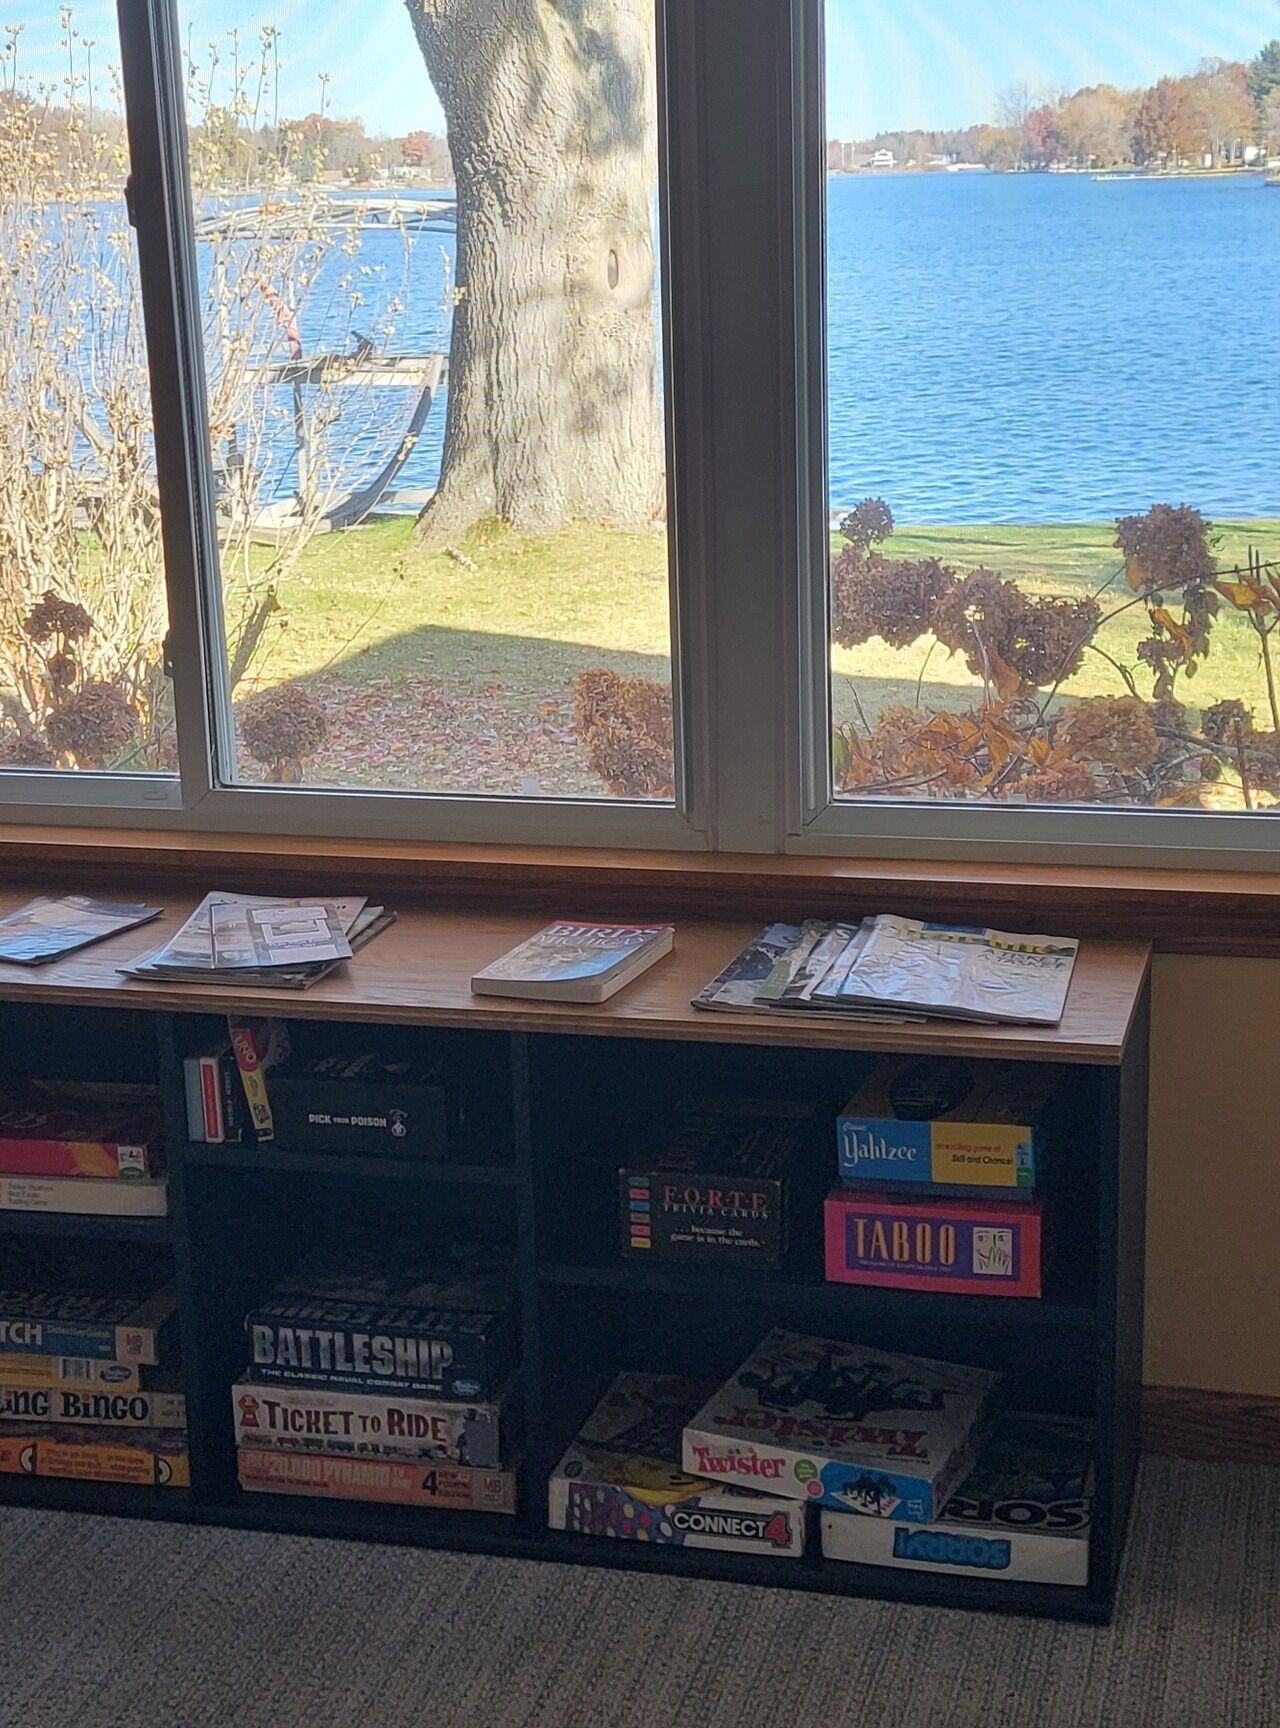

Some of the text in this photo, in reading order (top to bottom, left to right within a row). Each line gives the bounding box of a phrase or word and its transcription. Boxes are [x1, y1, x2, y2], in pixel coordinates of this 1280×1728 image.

[543, 924, 663, 938] BIRDS
[308, 1113, 332, 1125] PICK
[351, 1116, 387, 1128] POISON
[843, 1131, 918, 1168] Yahtzee
[663, 1202, 715, 1217] TRIVIA
[720, 1207, 769, 1220] CARDS
[854, 1218, 956, 1266] TABOO
[251, 1324, 454, 1380] BATTLESHIP
[261, 1368, 282, 1377] THE
[284, 1370, 328, 1380] CLASSIC
[330, 1375, 364, 1385] NAVAL
[366, 1378, 410, 1389] COMBAT
[412, 1382, 442, 1392] GAME
[262, 1399, 448, 1442] TICKET TO RIDE
[692, 1445, 787, 1479] Twister
[421, 1470, 438, 1496] 4
[673, 1512, 789, 1545] CONNECT 4
[942, 1496, 1090, 1531] SOR
